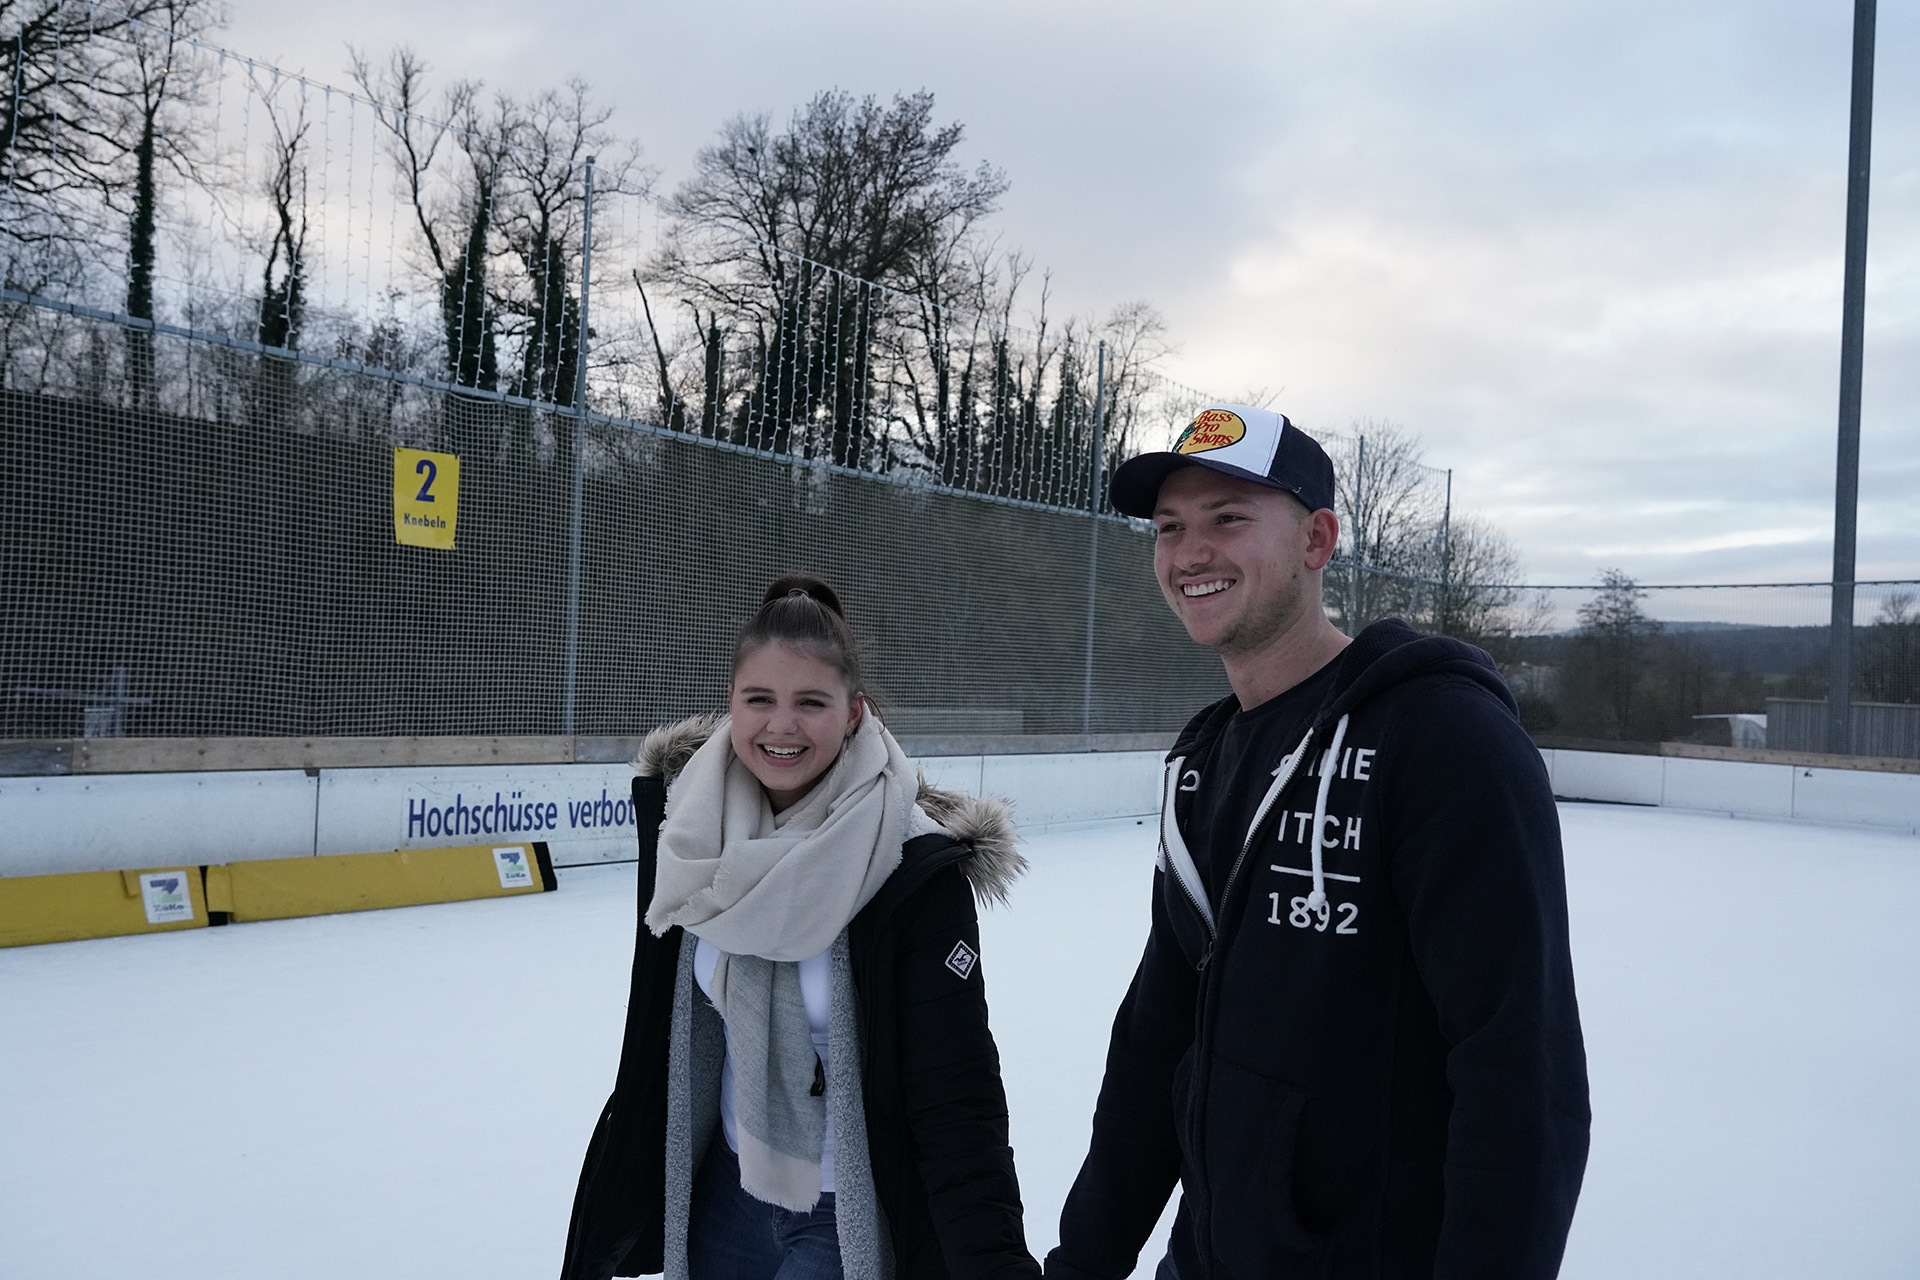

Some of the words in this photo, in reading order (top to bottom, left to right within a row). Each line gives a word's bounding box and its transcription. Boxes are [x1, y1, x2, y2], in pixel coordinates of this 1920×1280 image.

[1197, 409, 1234, 424] Bass
[1194, 422, 1220, 434] Pro
[1189, 433, 1234, 446] Shops
[415, 459, 437, 503] 2
[404, 513, 446, 528] Knebeln
[408, 792, 558, 838] Hochschüsse
[1267, 892, 1359, 935] 1892
